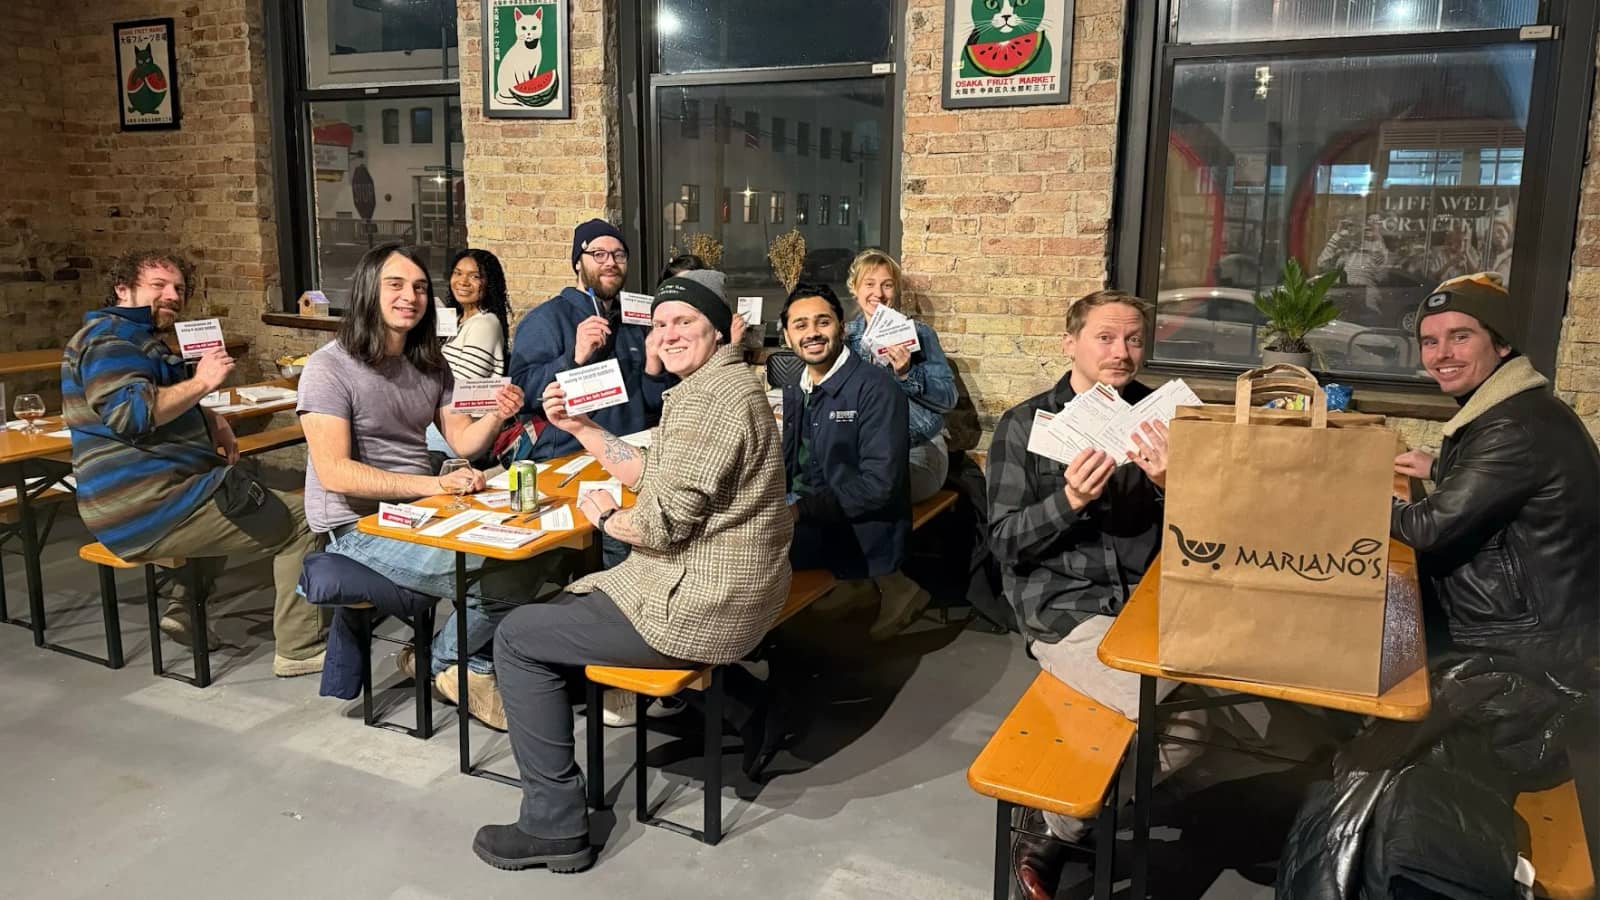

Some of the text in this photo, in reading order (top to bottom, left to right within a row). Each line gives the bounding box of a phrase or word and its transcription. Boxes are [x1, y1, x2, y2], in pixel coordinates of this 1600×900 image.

[955, 75, 1056, 88] OSAKA FRUIT MARKET
[1385, 195, 1504, 211] LIFE WELL
[1234, 545, 1382, 582] MARIANO'S
